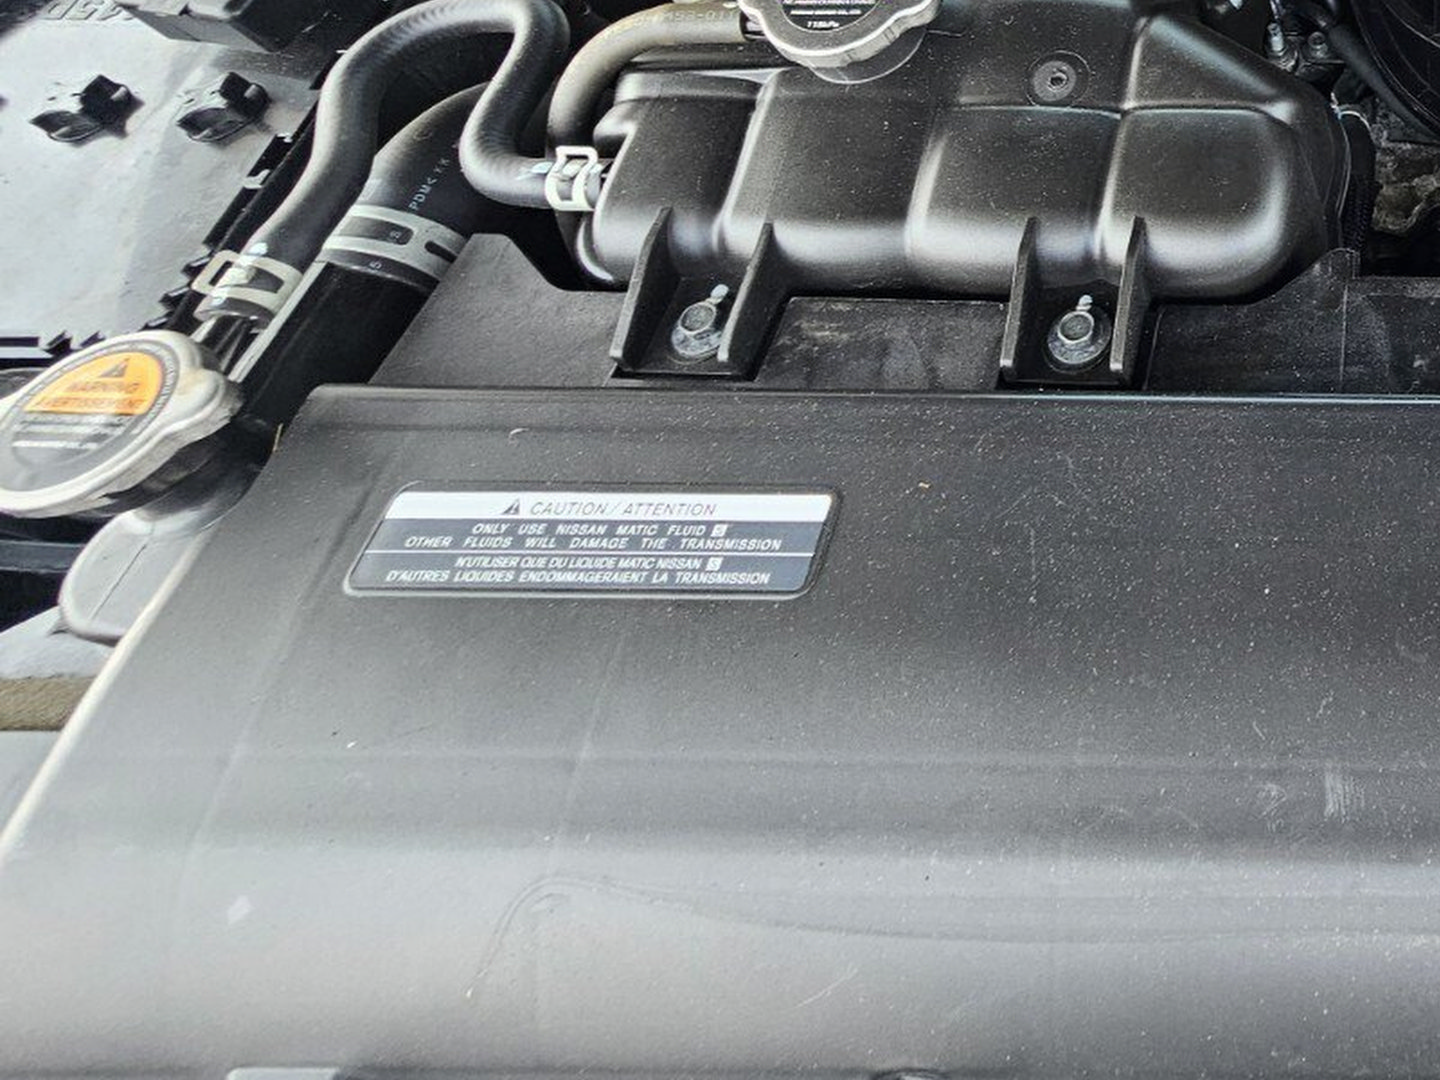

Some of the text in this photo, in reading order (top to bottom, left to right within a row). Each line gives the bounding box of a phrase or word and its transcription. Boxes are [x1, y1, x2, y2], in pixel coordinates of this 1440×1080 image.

[530, 501, 608, 516] CAUTION
[622, 502, 718, 517] ATTENTION
[472, 522, 507, 535] ONLY
[518, 523, 547, 535] USE
[555, 523, 607, 536] NISSAN
[616, 524, 657, 536] MATIC
[667, 524, 706, 536] FLUID
[404, 536, 782, 551] OTHER FLUIDS WILL DAMAGE THE TRANSMISSION
[520, 556, 547, 568] QUE
[549, 557, 568, 568] DU
[568, 557, 618, 569] LIQUIDE
[617, 557, 655, 569] MATIC
[655, 558, 703, 570] NISSAN
[453, 570, 514, 583] LIQUIDES
[652, 572, 668, 584] LA
[675, 572, 771, 585] TRANSMISSION
